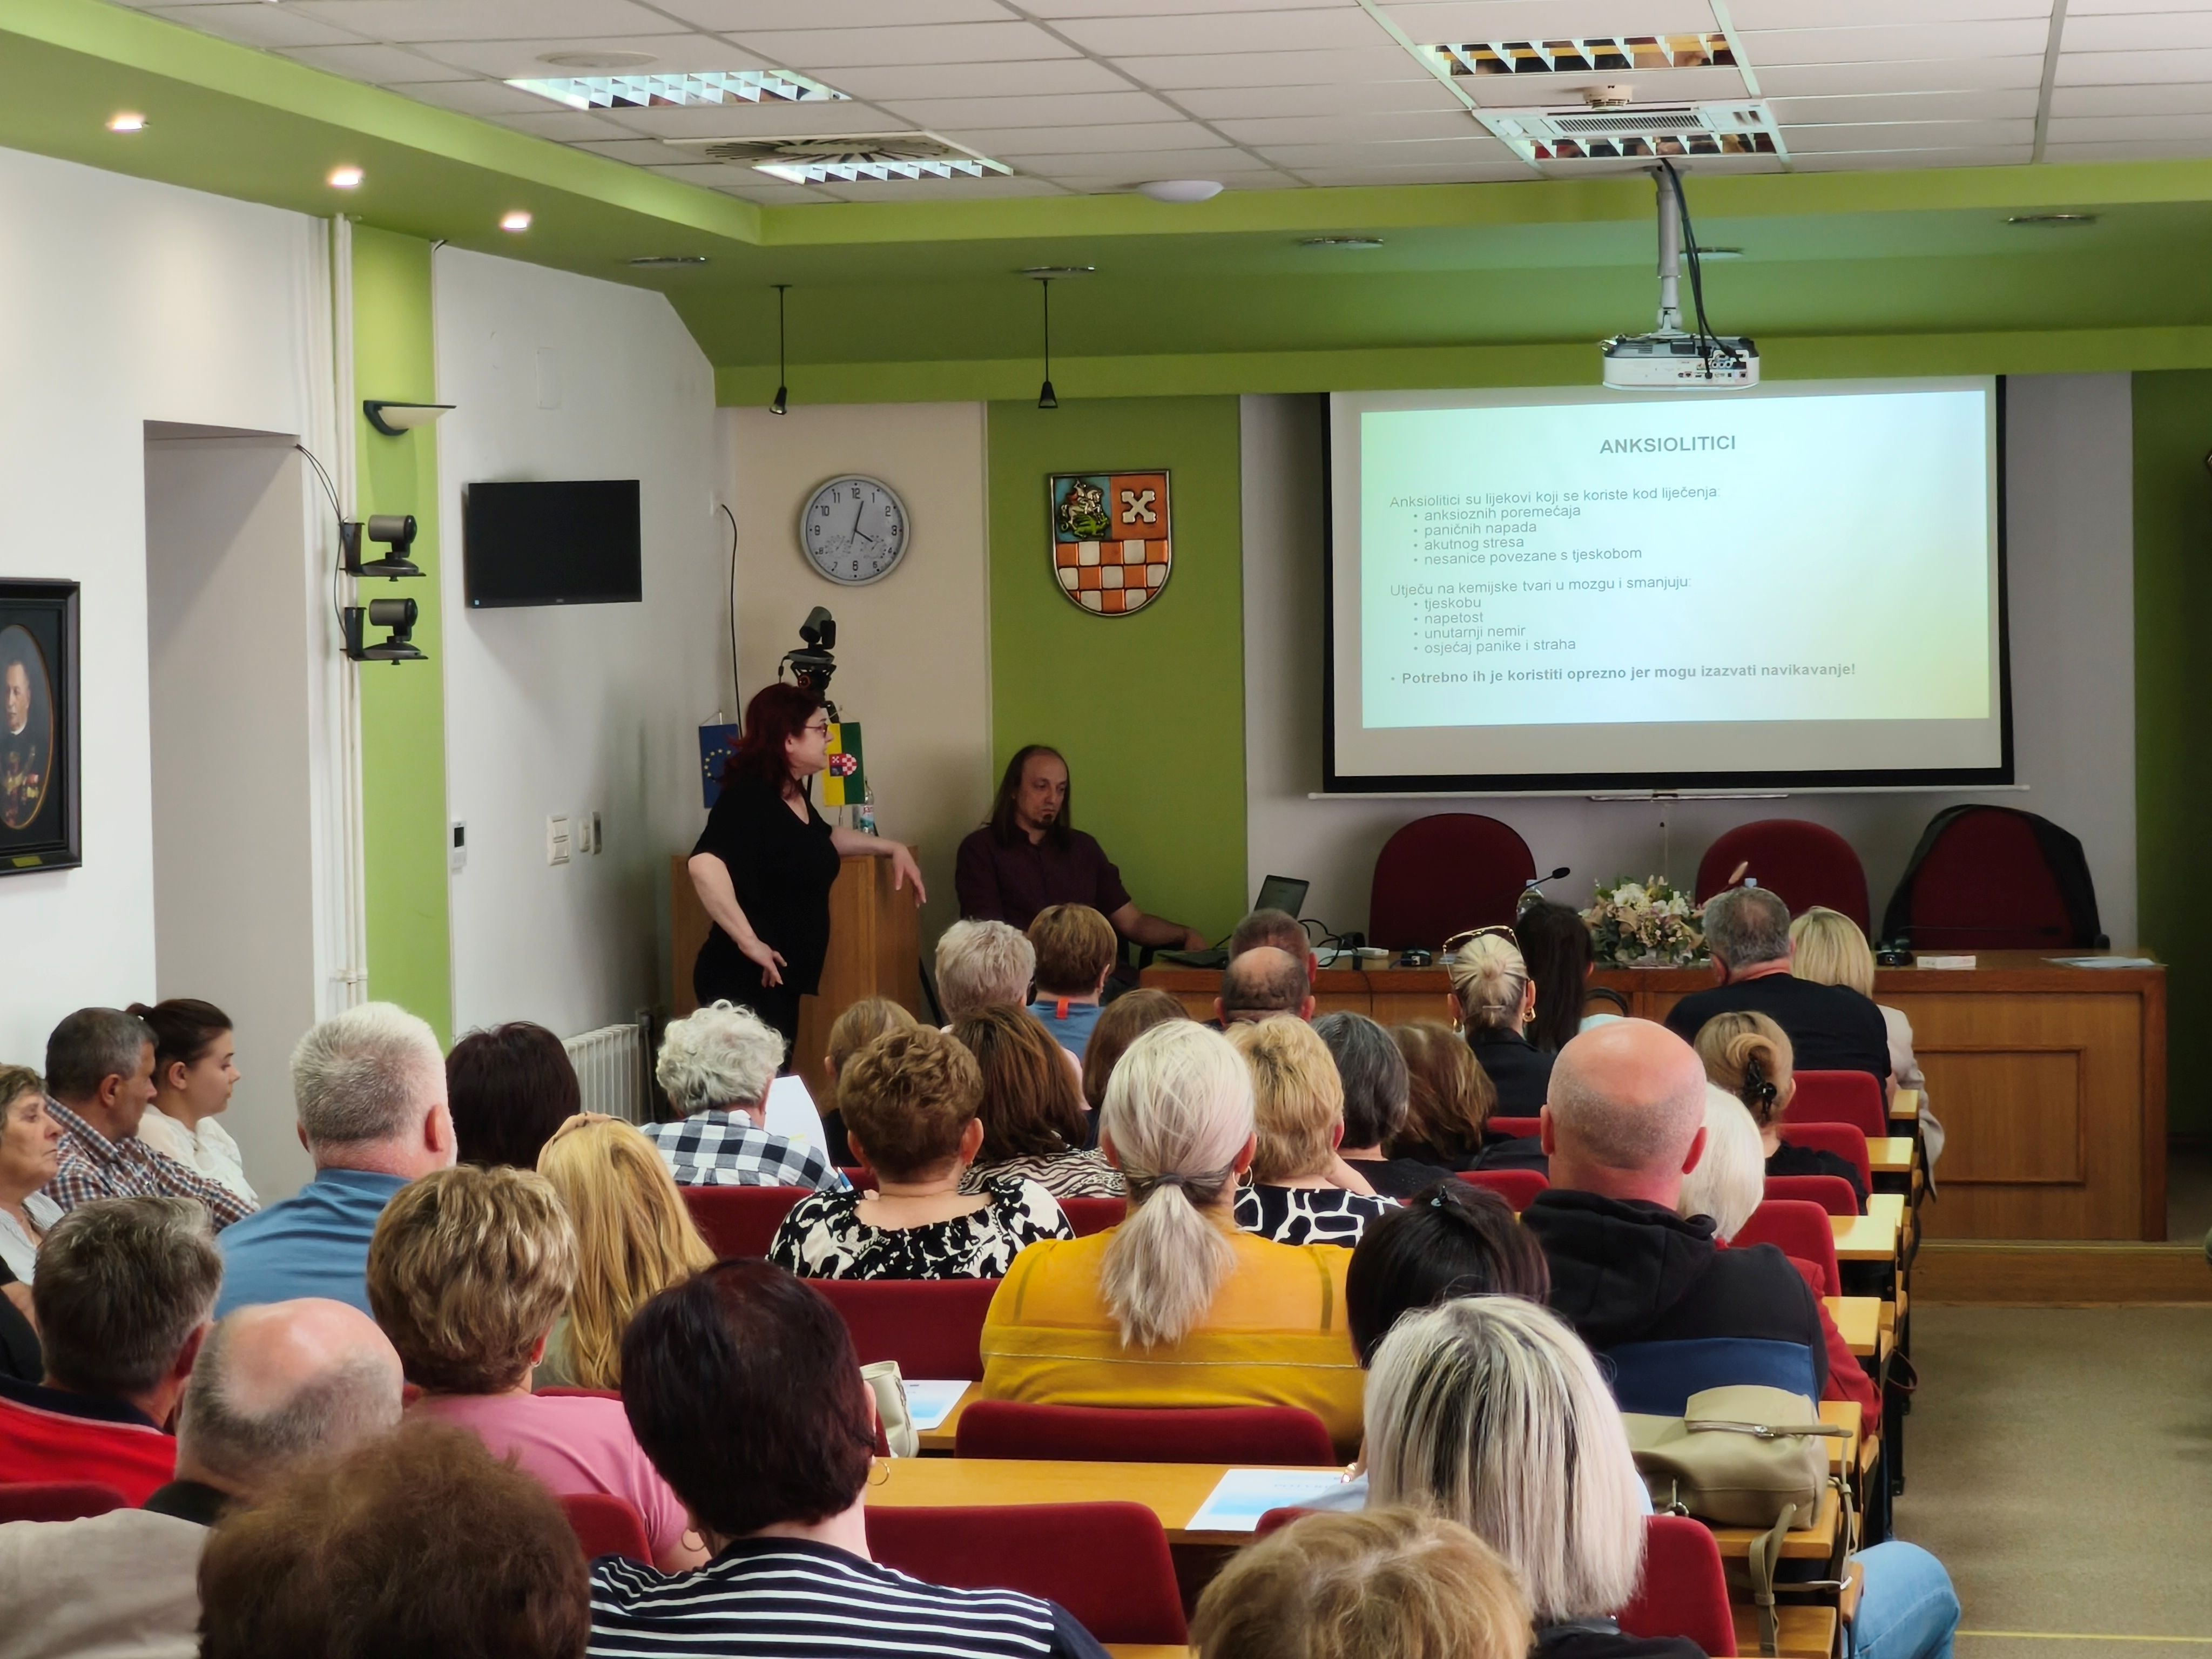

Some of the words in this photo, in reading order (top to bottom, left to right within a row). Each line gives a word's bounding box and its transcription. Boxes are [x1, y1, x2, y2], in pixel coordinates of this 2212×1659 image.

[1599, 435, 1736, 454] ANKSIOLITICI
[833, 492, 840, 503] 11
[851, 488, 861, 499] 12
[1390, 494, 1461, 508] Anksiolitici
[1465, 495, 1482, 505] su
[1486, 491, 1532, 507] lijekovi
[1535, 490, 1559, 505] koji
[1563, 492, 1579, 502] se
[1583, 489, 1628, 501] koriste
[1633, 488, 1658, 500] kod
[820, 505, 830, 516] 10
[885, 505, 891, 517] 2
[1424, 507, 1496, 521] anksioznih
[1501, 504, 1581, 521] poremećaja
[891, 525, 897, 536] 3
[1424, 523, 1481, 538] paničnih
[1485, 521, 1537, 536] napada
[1424, 538, 1479, 551] akutnog
[1482, 537, 1525, 549] stresa
[1424, 552, 1486, 565] nesanice
[1489, 551, 1557, 565] povezane
[1560, 551, 1568, 561] s
[1572, 548, 1642, 563] tjeskobom
[1390, 583, 1433, 598] Utječu
[1437, 584, 1454, 594] na
[1458, 581, 1518, 596] kemijske
[1522, 579, 1552, 592] tvari
[1556, 581, 1564, 591] u
[1568, 579, 1615, 592] mozgu
[1424, 597, 1481, 612] tjeskobu
[1424, 611, 1483, 627] napetost
[1424, 626, 1483, 640] unutarnji
[1487, 625, 1526, 637] nemir
[1424, 641, 1472, 656] osjećaj
[1476, 639, 1521, 655] panike
[1533, 638, 1576, 651] straha
[1402, 671, 1468, 685] Potrebno
[1473, 670, 1486, 683] ih
[1489, 670, 1503, 685] je
[1507, 668, 1563, 681] koristiti
[1567, 668, 1626, 683] oprezno
[1630, 666, 1650, 681] jer
[1655, 666, 1696, 680] mogu
[1701, 664, 1757, 677] izazvati
[1761, 663, 1856, 678] navikavanje!
